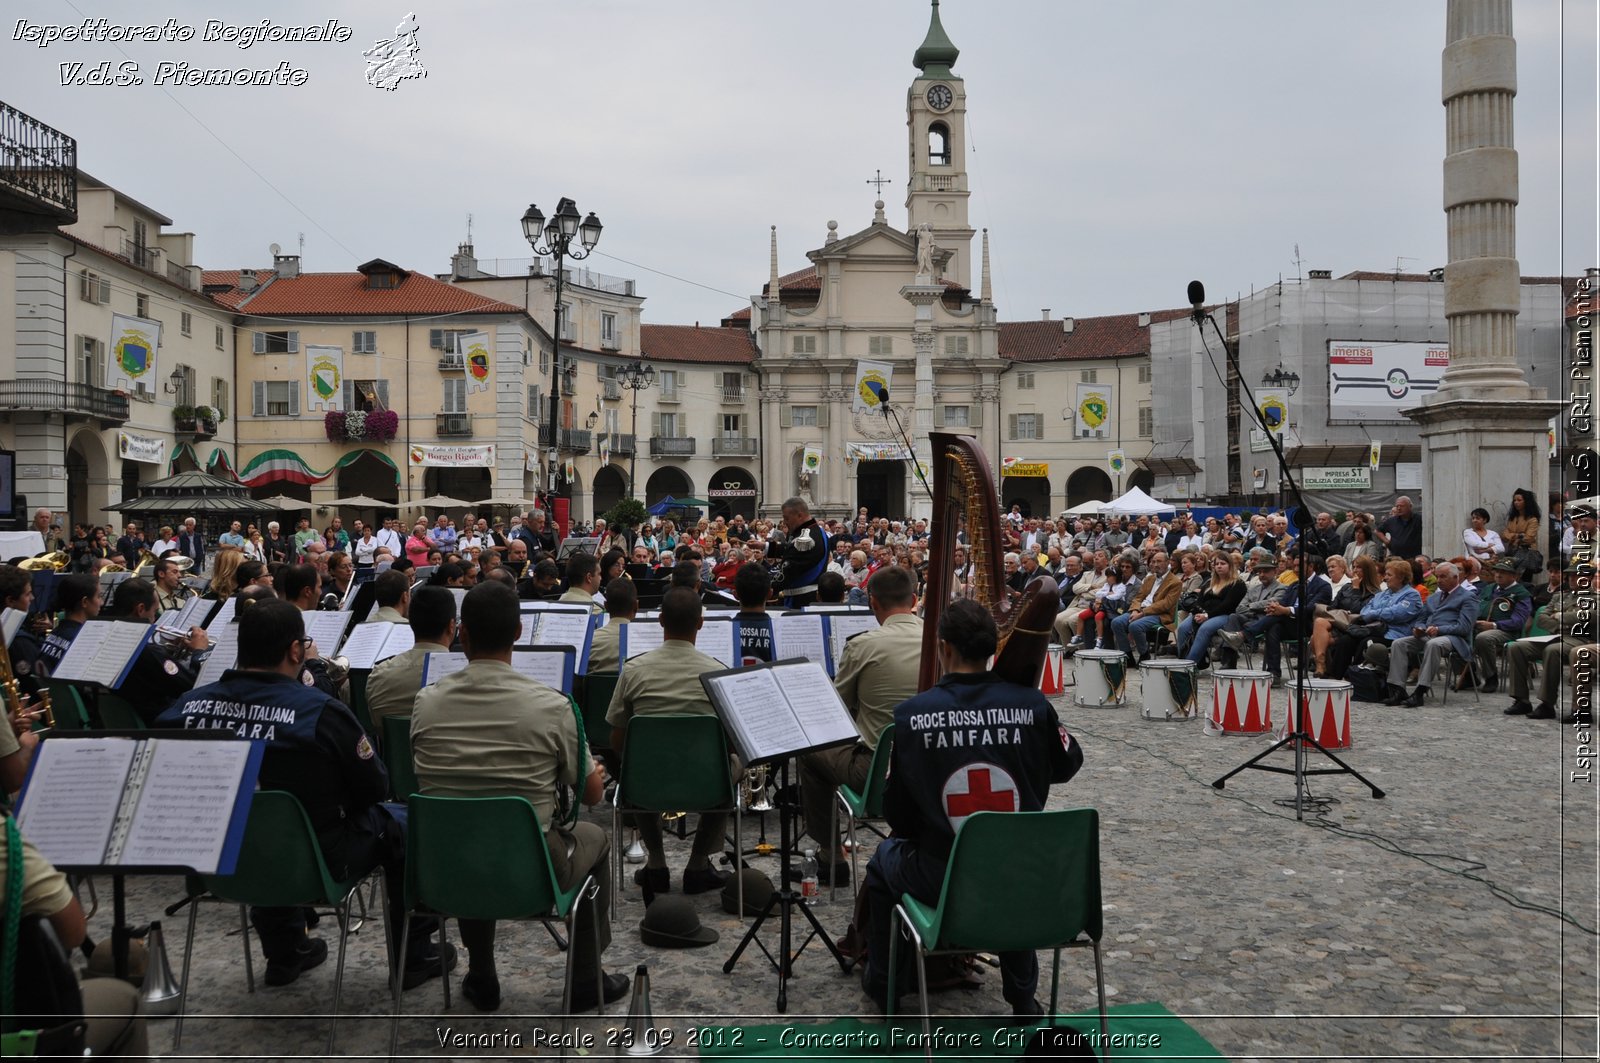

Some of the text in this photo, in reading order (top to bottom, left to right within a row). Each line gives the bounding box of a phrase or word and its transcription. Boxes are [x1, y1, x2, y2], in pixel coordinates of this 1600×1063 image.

[1335, 348, 1372, 356] mensa
[427, 453, 482, 461] Borgo Rigola
[1351, 468, 1363, 477] ST
[182, 700, 296, 725] CROCE ROSSA ITALIANA
[910, 708, 1034, 730] CROCE ROSSA ITALIANA
[924, 728, 1022, 749] FANFARA
